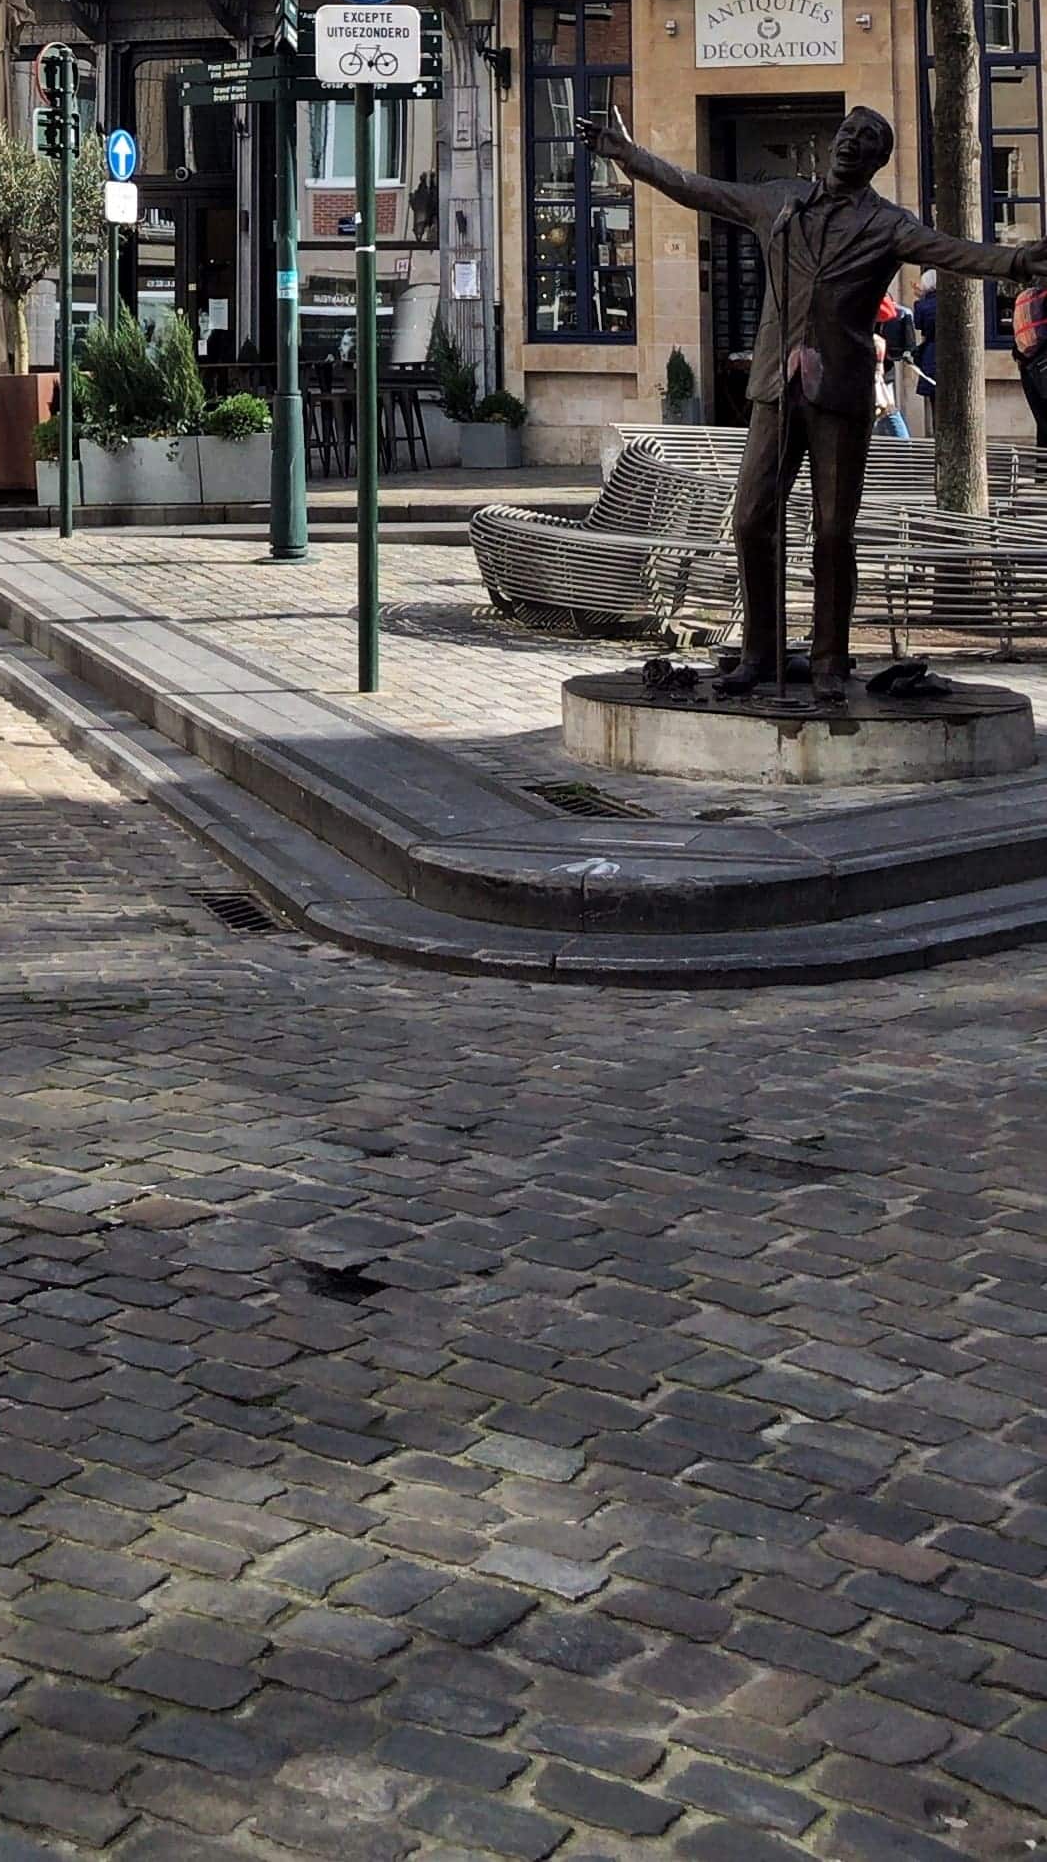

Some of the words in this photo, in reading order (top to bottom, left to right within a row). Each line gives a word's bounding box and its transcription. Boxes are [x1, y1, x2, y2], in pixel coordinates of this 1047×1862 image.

[343, 12, 393, 24] EXCEPTE
[327, 26, 410, 38] UITGEZONDERD
[703, 40, 837, 60] DÉCORATION
